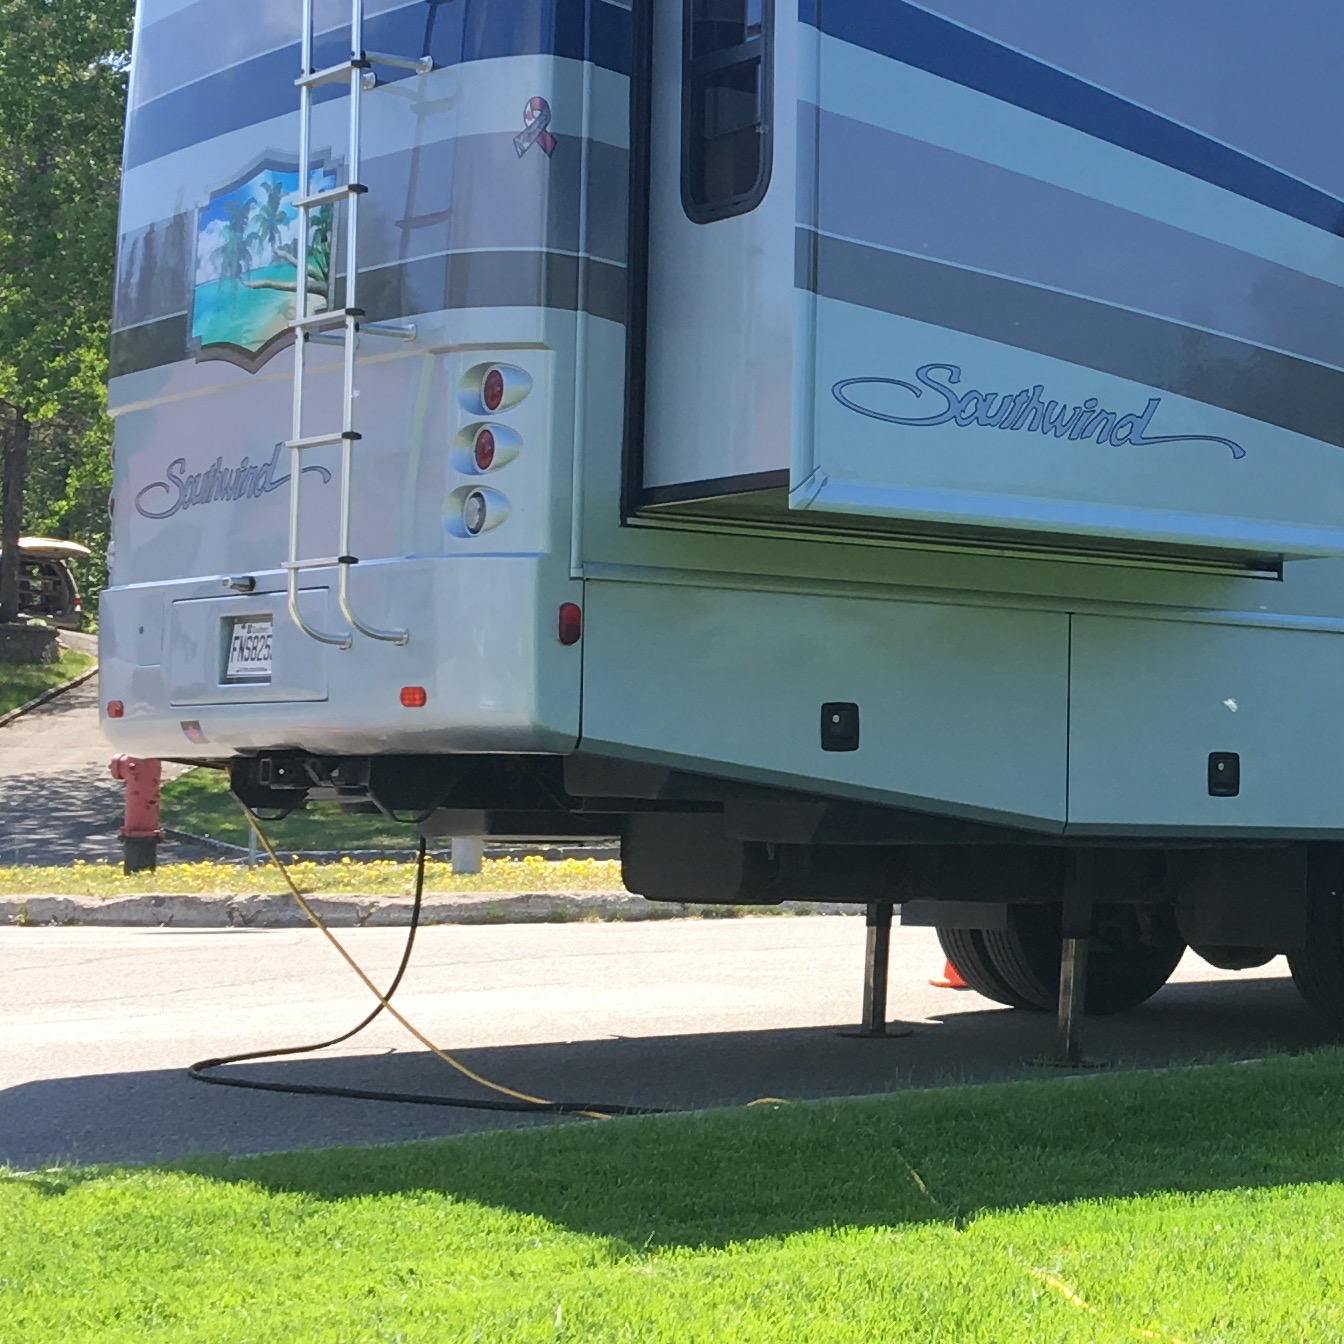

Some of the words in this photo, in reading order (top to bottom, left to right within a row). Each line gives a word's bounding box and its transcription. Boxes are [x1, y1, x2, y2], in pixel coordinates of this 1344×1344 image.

[831, 363, 1246, 459] Southwind
[135, 442, 331, 519] Southwind
[230, 635, 272, 663] FNS825
